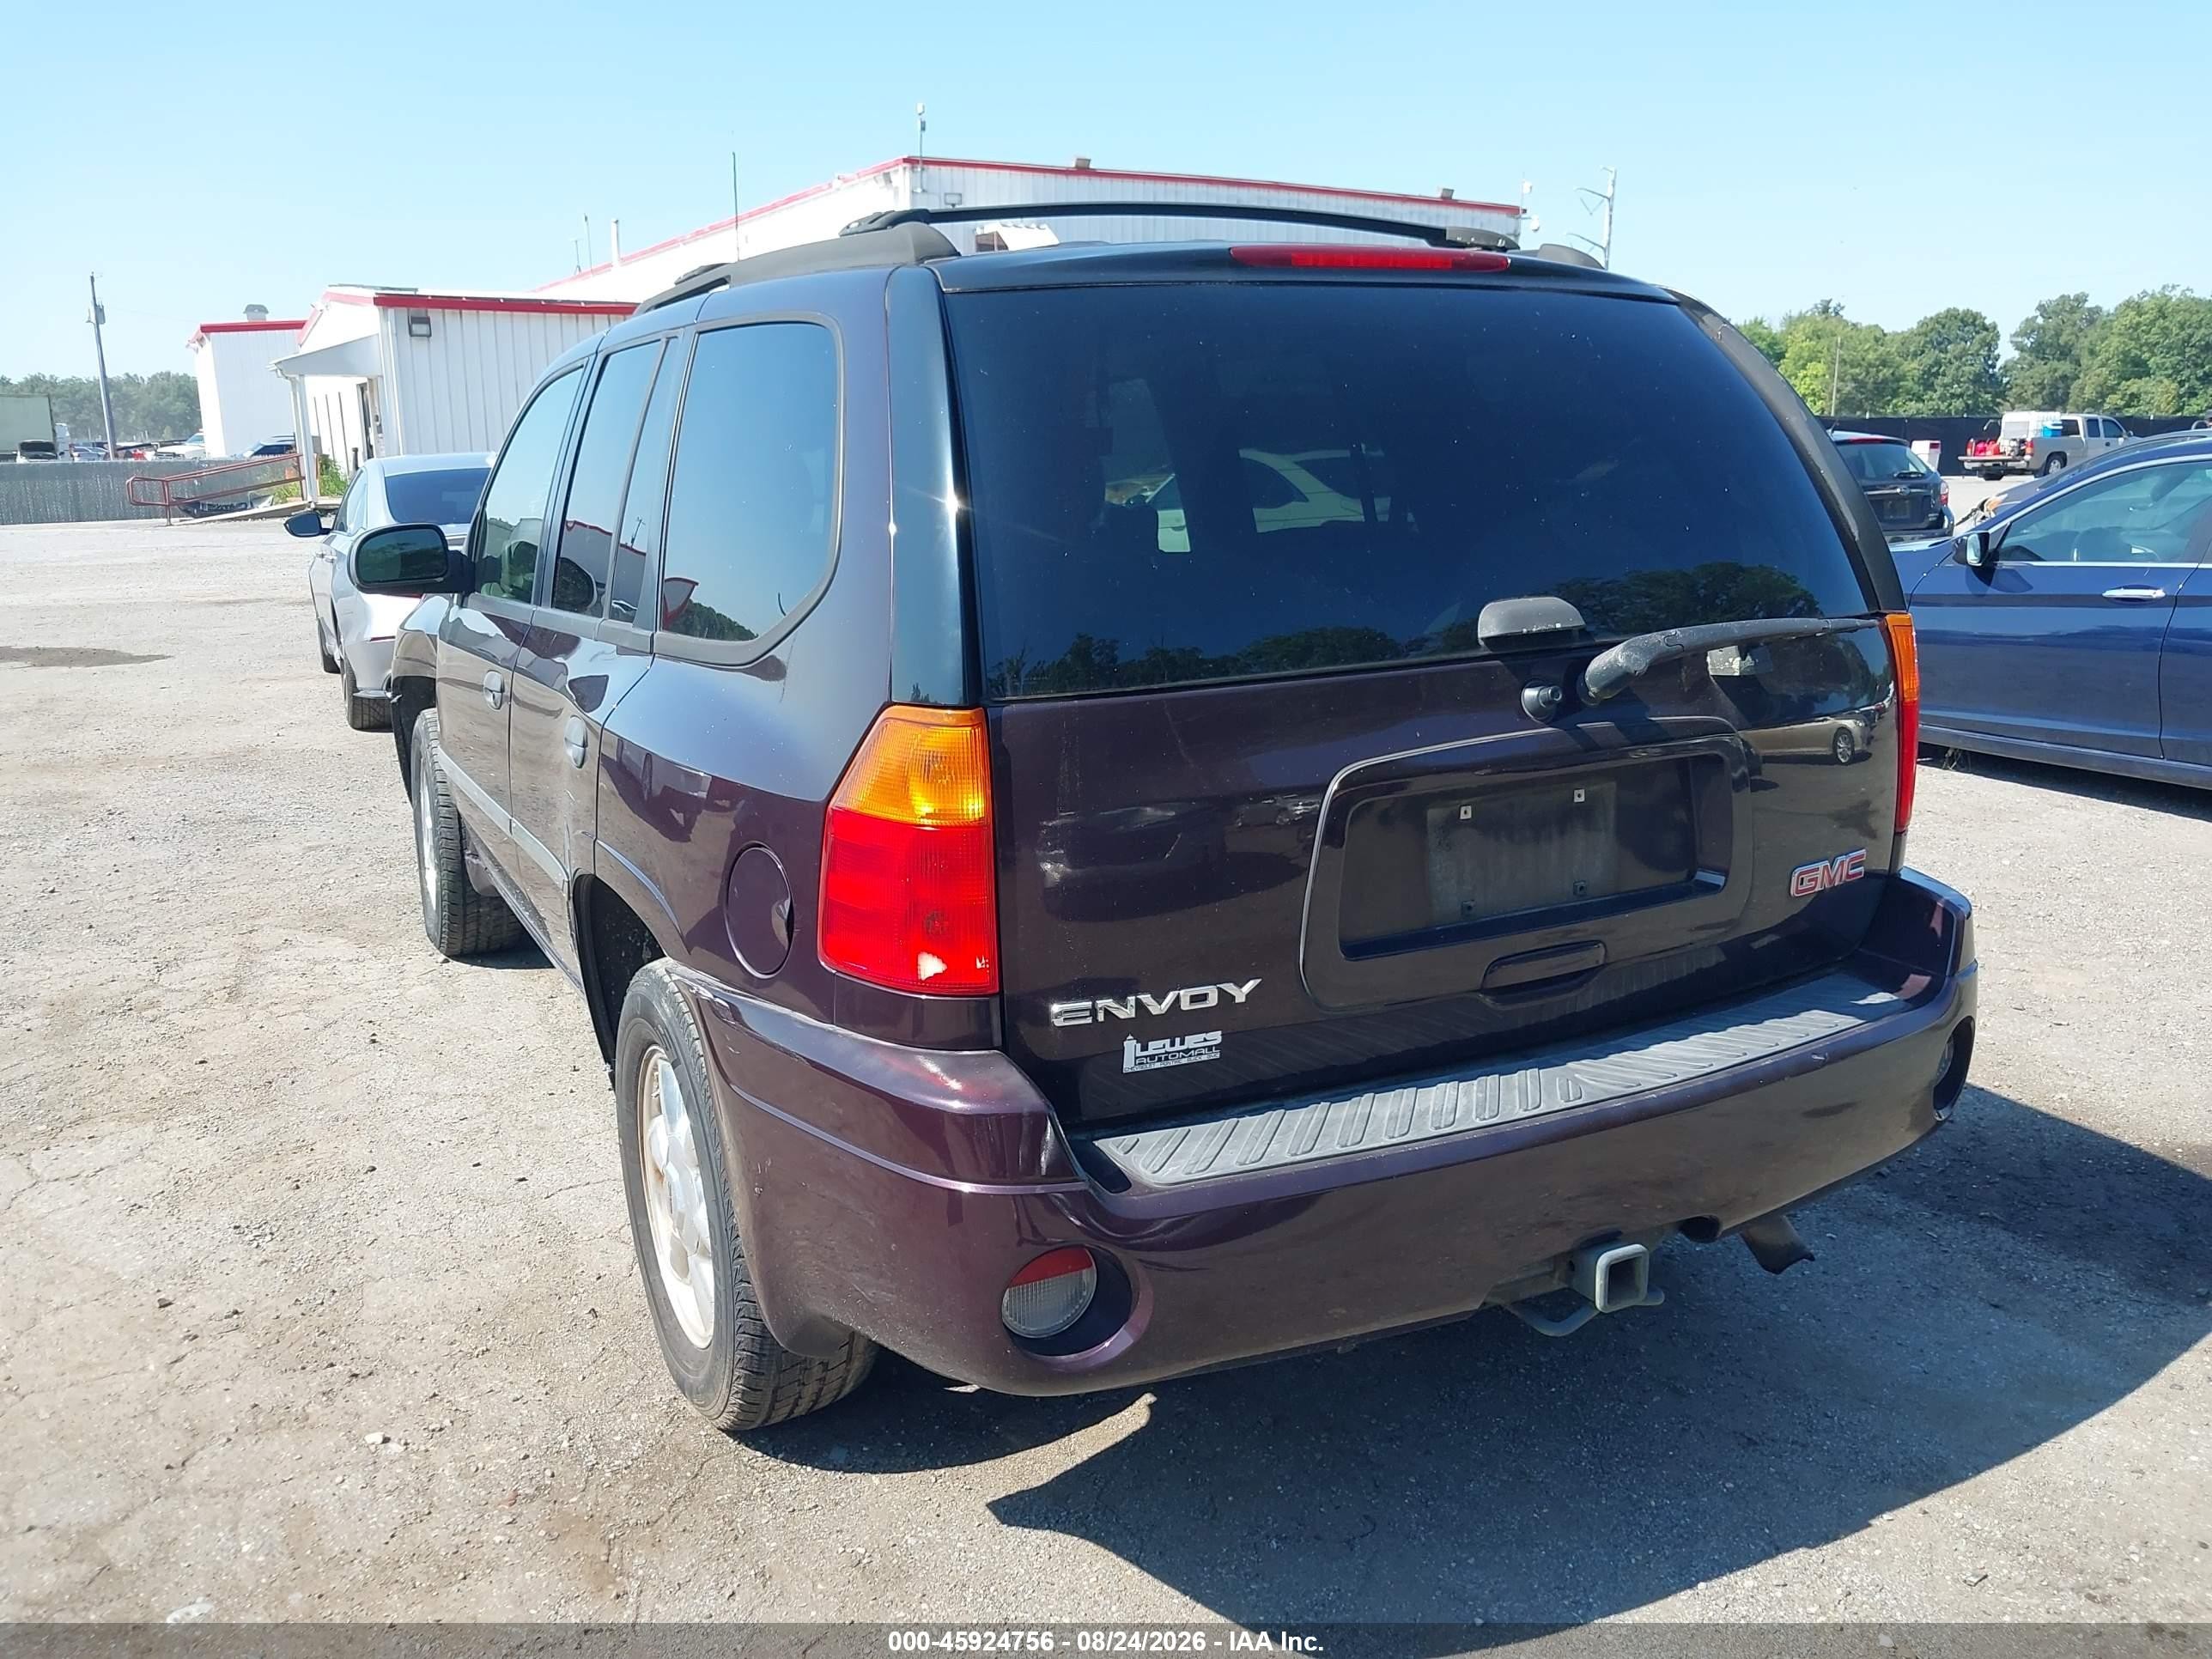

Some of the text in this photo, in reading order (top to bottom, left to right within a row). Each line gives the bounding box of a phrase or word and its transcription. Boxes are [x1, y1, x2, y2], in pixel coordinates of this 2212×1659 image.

[1790, 848, 1867, 896] GMC
[1051, 978, 1262, 1027] ENVOY
[1136, 1046, 1221, 1065] AUTOMALL
